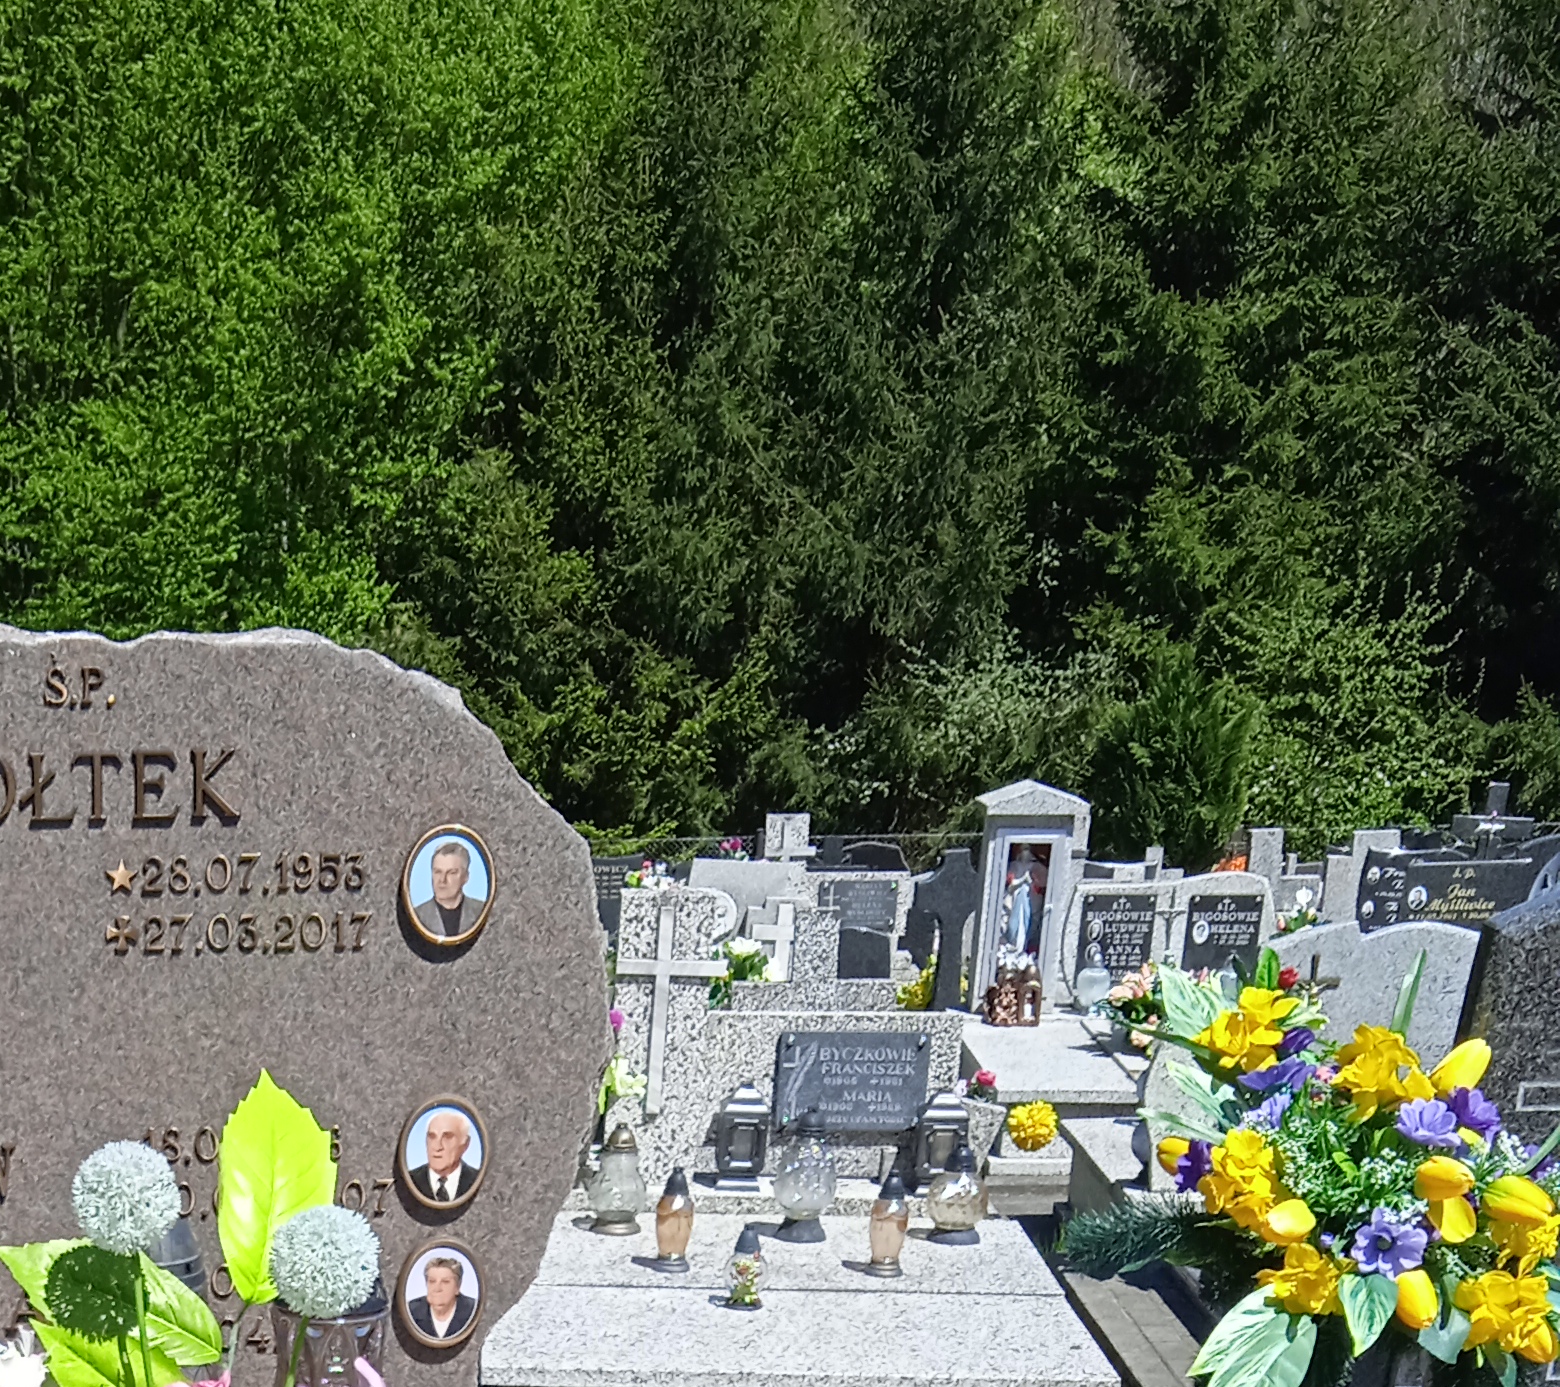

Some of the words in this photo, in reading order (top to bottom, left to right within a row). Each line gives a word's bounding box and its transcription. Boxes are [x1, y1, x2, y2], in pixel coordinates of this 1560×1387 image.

[42, 653, 117, 709] Ś.P.
[140, 848, 366, 898] 28.07.1953
[142, 910, 373, 957] 27.03.2017
[1104, 922, 1150, 933] LUDWIK
[1106, 944, 1142, 955] ANNA
[819, 1047, 918, 1062] BYCZKOWIE
[821, 1062, 916, 1076] FRANCISZEK
[842, 1090, 892, 1103] MARIA
